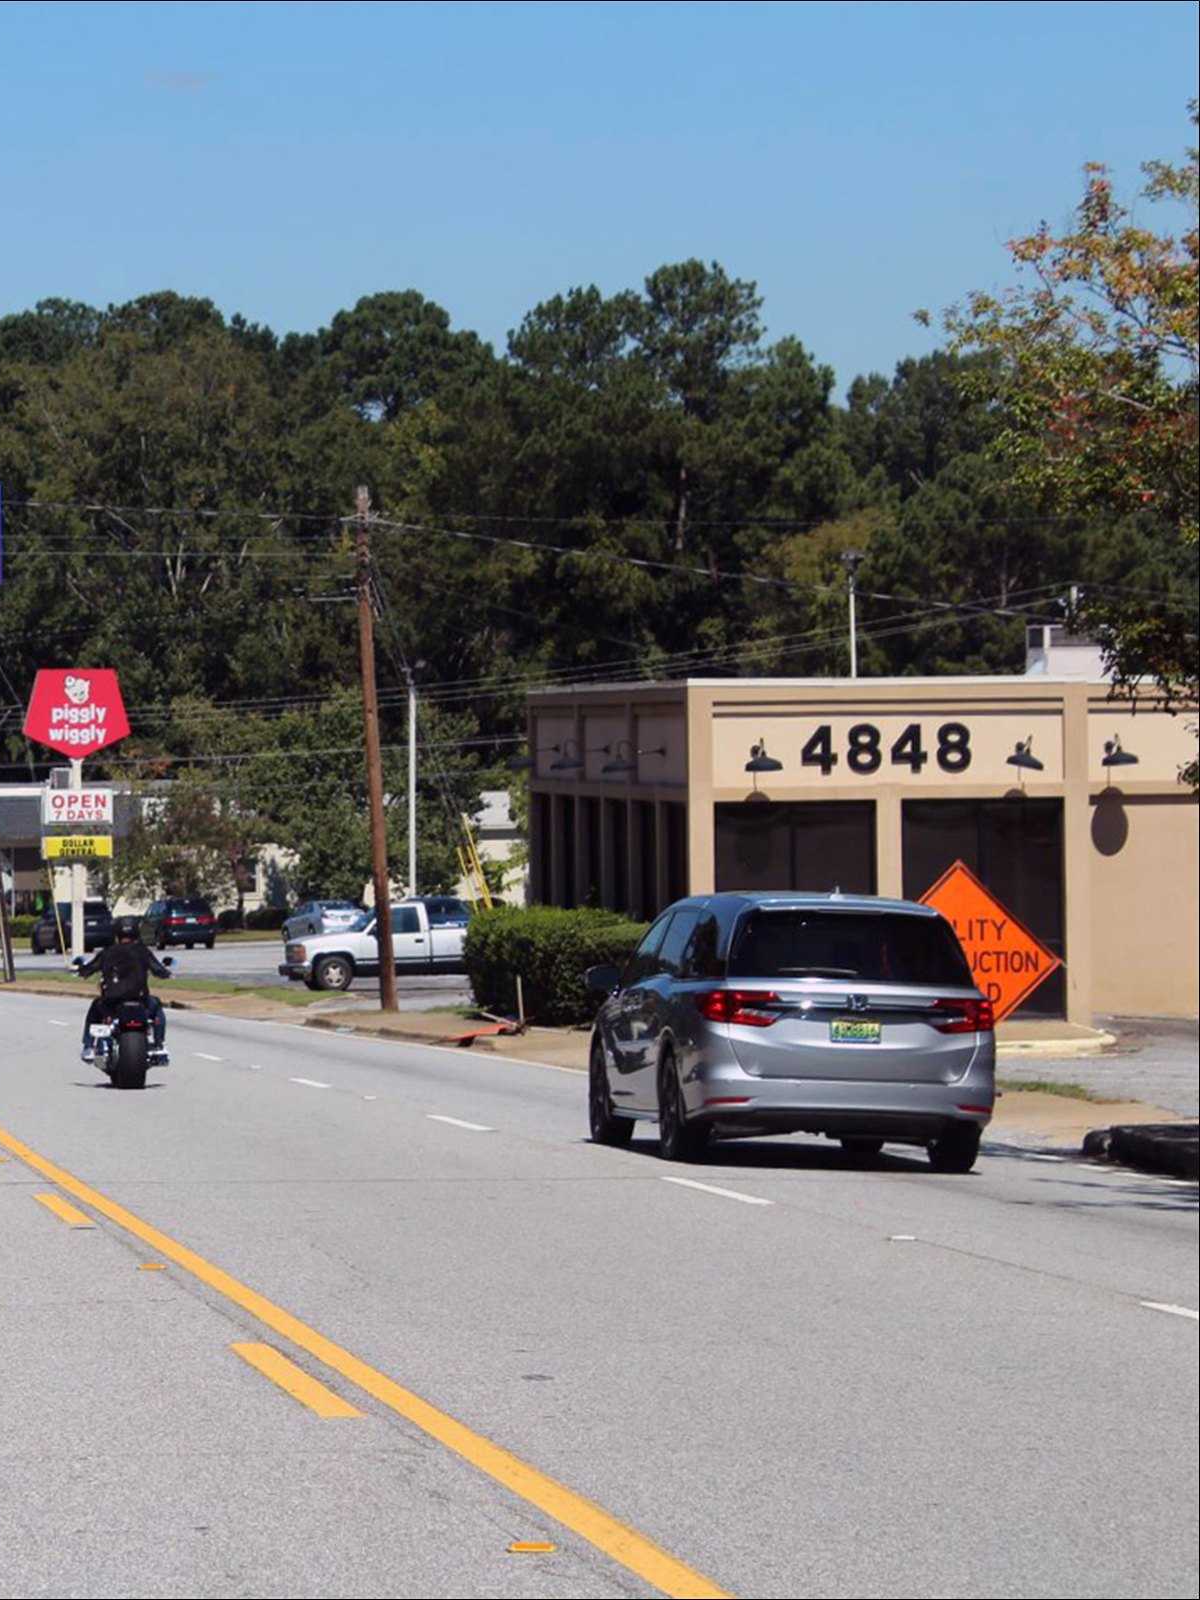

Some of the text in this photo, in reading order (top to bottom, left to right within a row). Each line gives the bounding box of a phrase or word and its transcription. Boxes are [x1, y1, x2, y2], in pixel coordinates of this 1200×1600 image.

[51, 703, 106, 724] piggly
[48, 724, 106, 745] wiggly
[801, 722, 972, 776] 4848
[52, 793, 107, 809] OPEN
[54, 809, 104, 820] 7 DAYS
[61, 839, 95, 848] DOLLAR
[952, 918, 1008, 941] LITY
